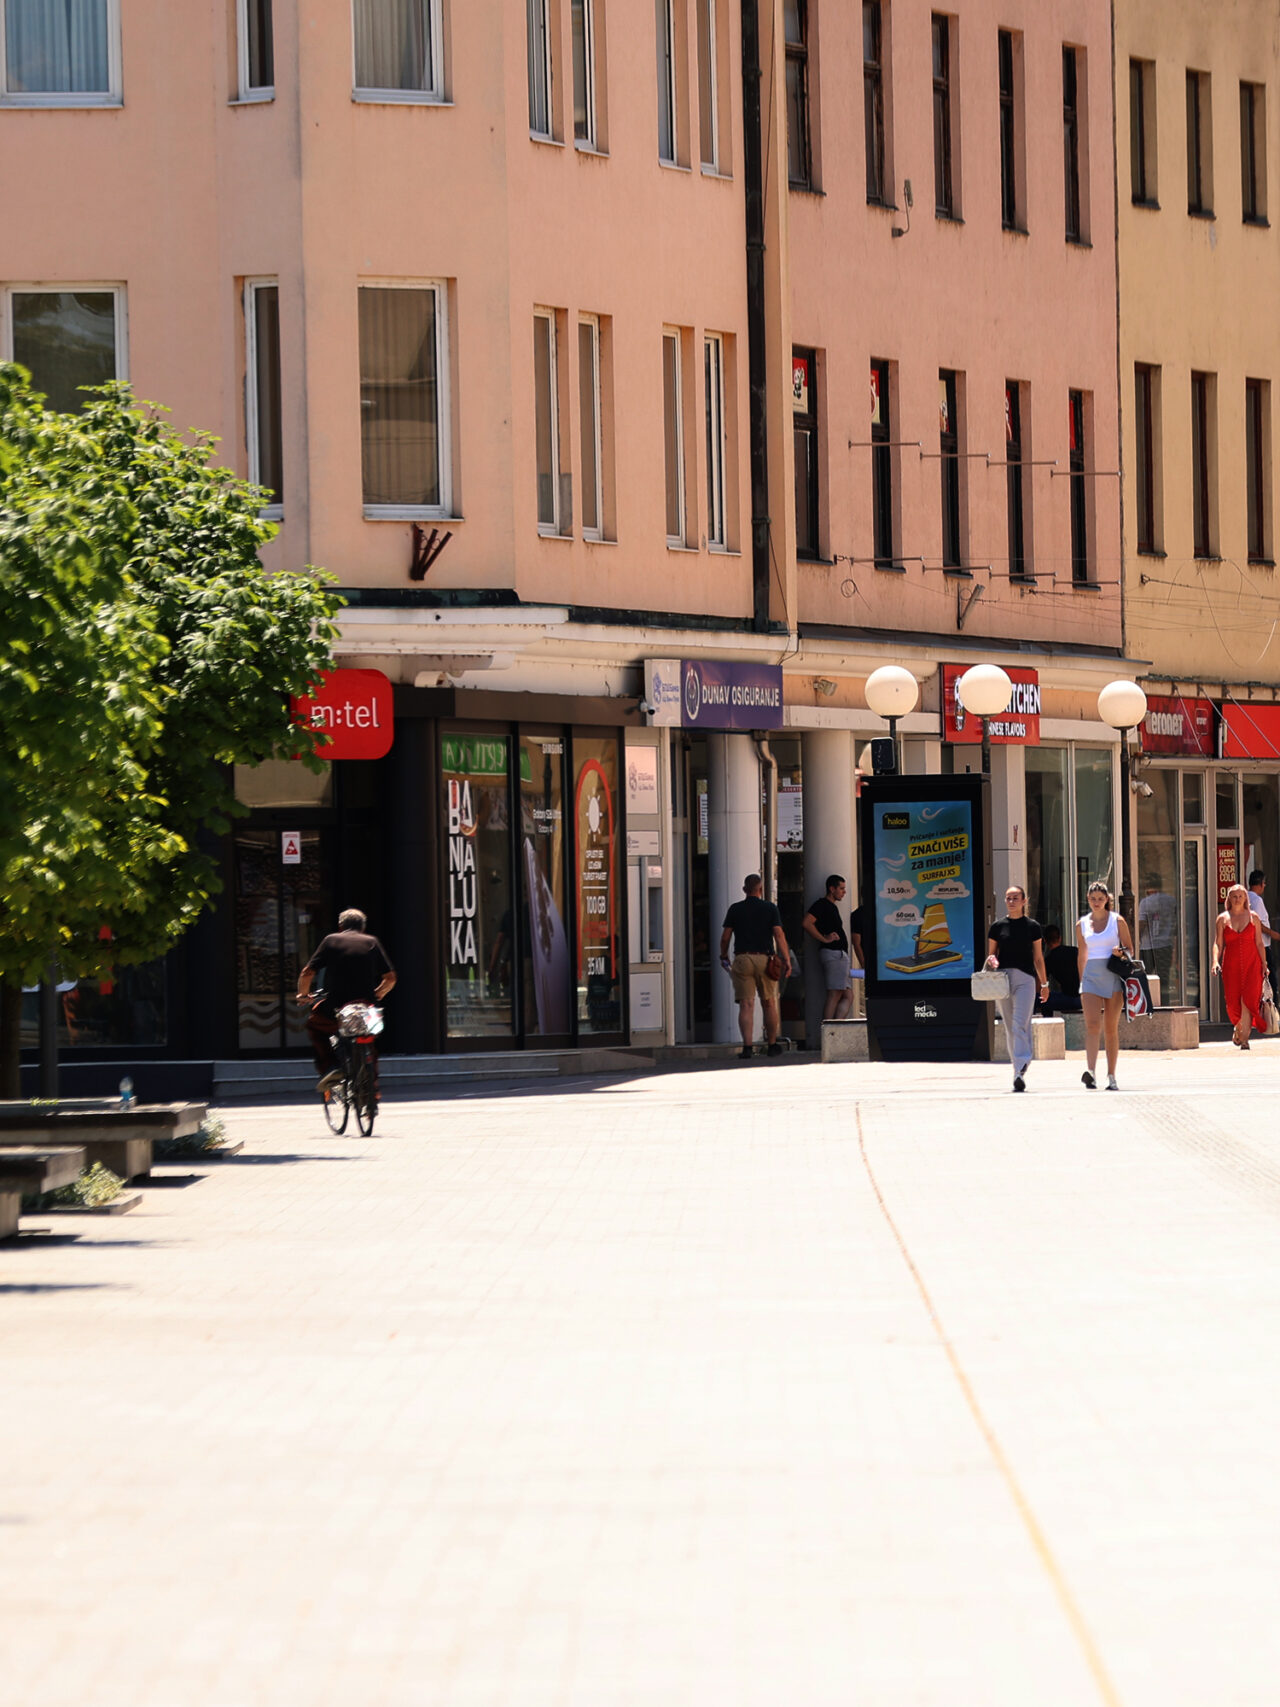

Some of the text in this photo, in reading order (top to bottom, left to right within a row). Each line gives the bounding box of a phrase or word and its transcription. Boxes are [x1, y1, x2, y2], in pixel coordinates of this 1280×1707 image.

[702, 685, 780, 707] DUNAV OSIGURANJE
[1005, 683, 1041, 715] TCHEN
[311, 697, 380, 728] m:tel
[1005, 722, 1026, 738] FLAVORS
[911, 836, 966, 857] ZNAČI VIŠE
[450, 836, 476, 880] NJA
[911, 850, 966, 871] za manje!
[922, 868, 957, 881] SURFAJ XS
[451, 873, 477, 919] LU
[586, 895, 607, 914] 100 GB
[451, 920, 478, 965] KA
